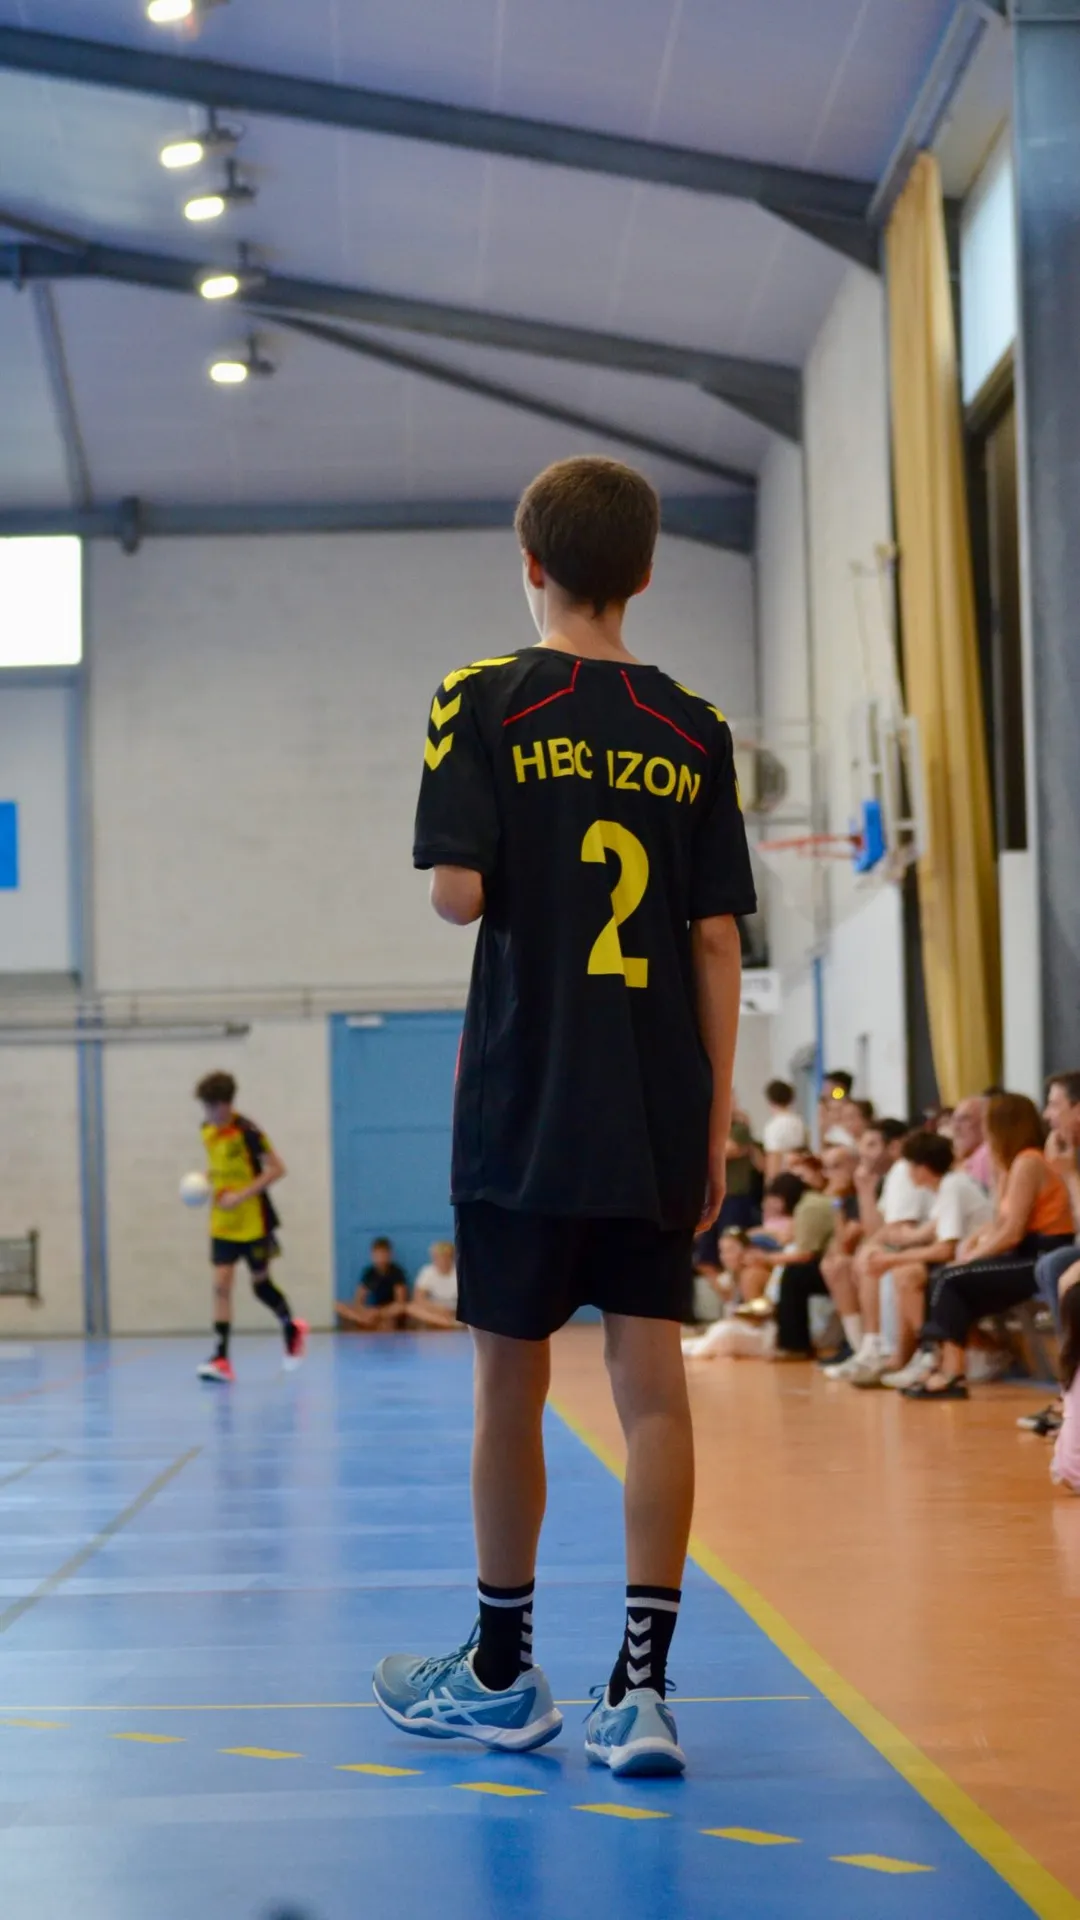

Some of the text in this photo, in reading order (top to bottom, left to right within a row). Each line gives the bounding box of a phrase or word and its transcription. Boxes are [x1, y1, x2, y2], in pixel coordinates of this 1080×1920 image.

[512, 737, 701, 804] HBC IZON
[581, 820, 649, 988] 2
